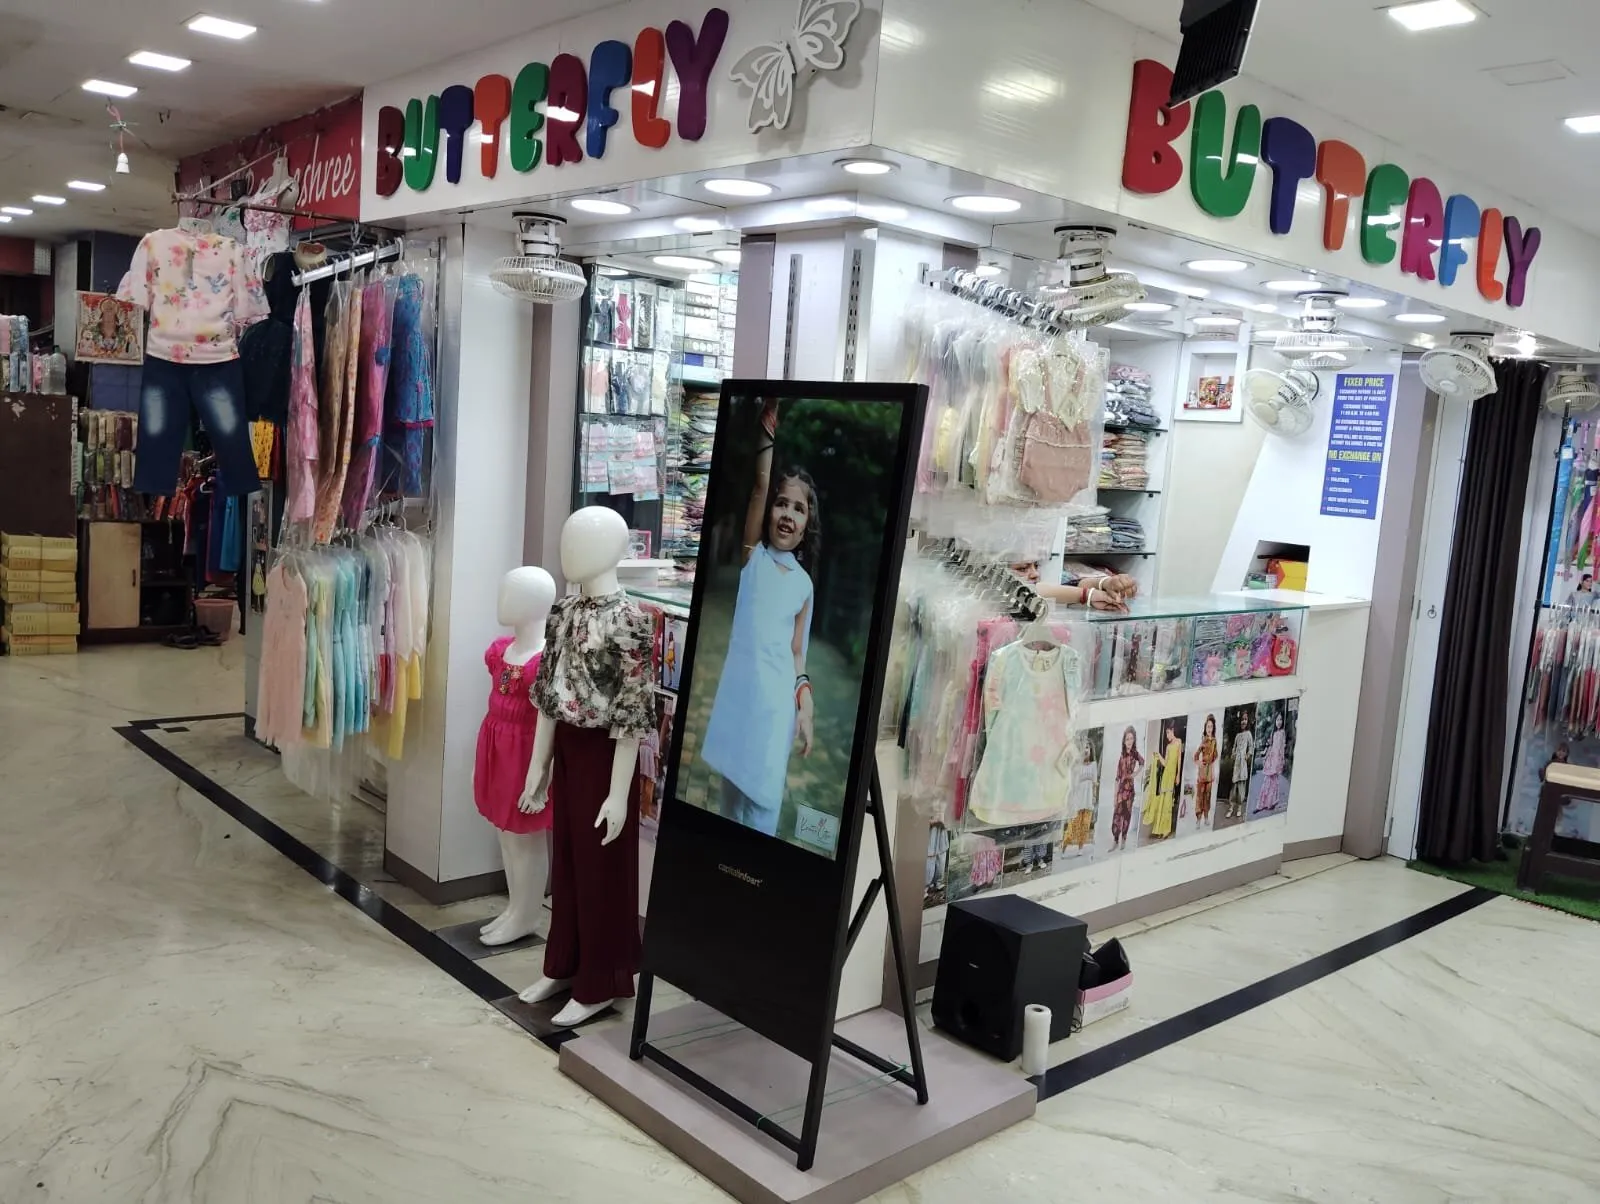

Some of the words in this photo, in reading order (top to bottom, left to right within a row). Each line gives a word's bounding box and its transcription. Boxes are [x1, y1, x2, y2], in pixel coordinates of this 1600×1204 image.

[376, 7, 729, 197] BUTTERFLY
[1122, 59, 1541, 307] BUTTERFLY
[1344, 377, 1364, 387] FIXED
[1365, 377, 1385, 387] PRICE
